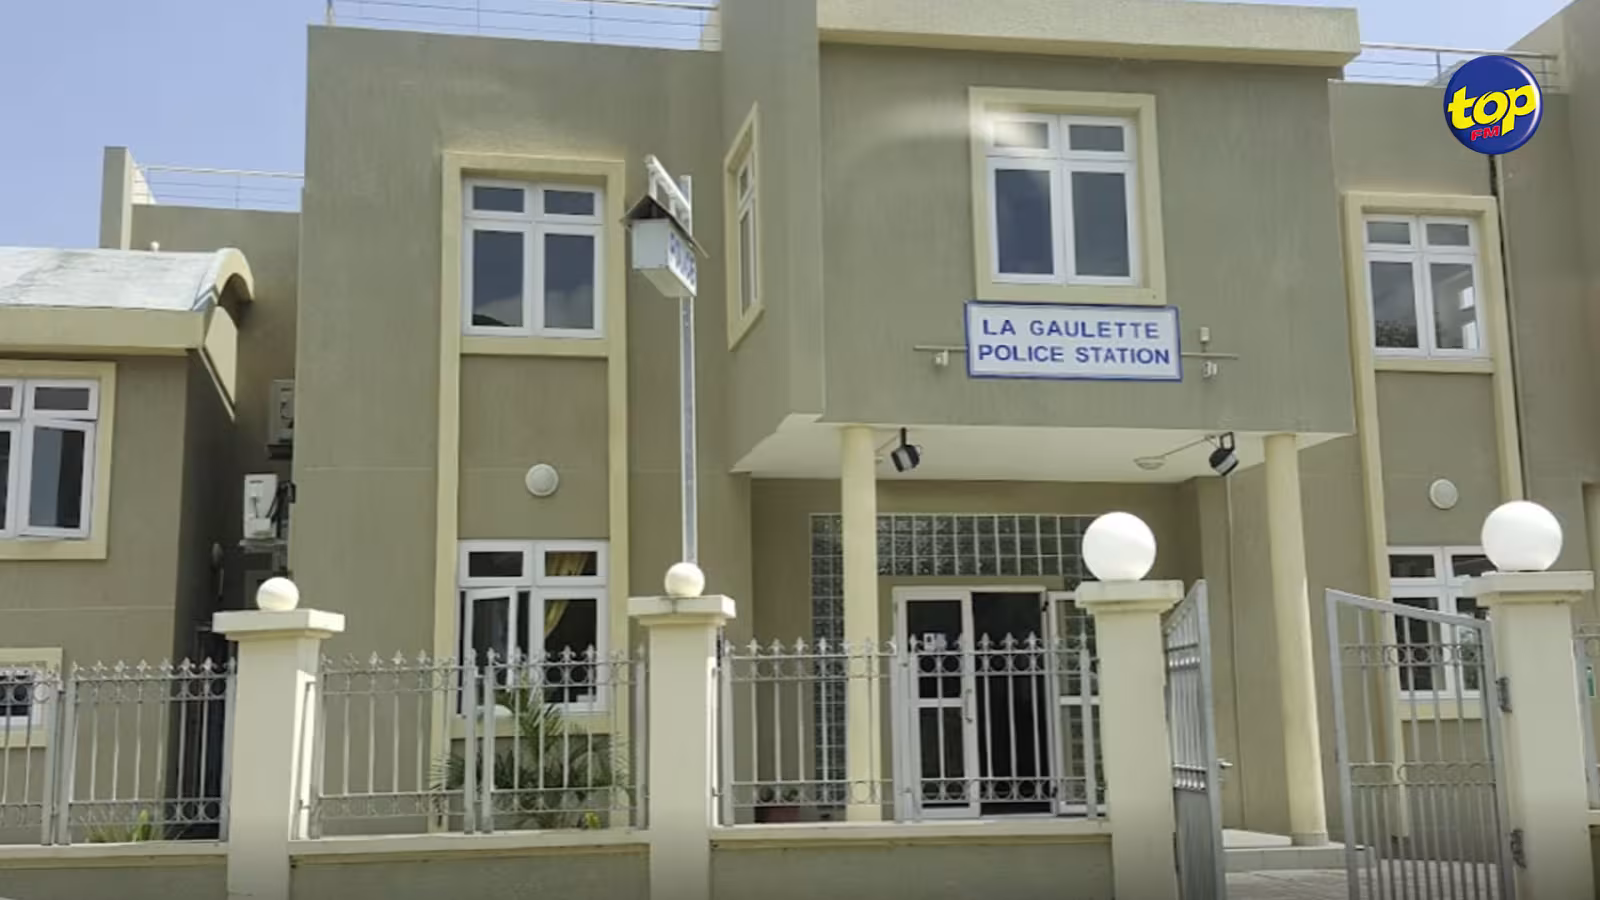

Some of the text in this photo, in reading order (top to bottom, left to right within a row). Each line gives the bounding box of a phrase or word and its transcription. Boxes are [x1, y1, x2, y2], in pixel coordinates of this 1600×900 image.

[983, 319, 1160, 339] LA GAULETTE
[978, 344, 1170, 364] POLICE STATION
